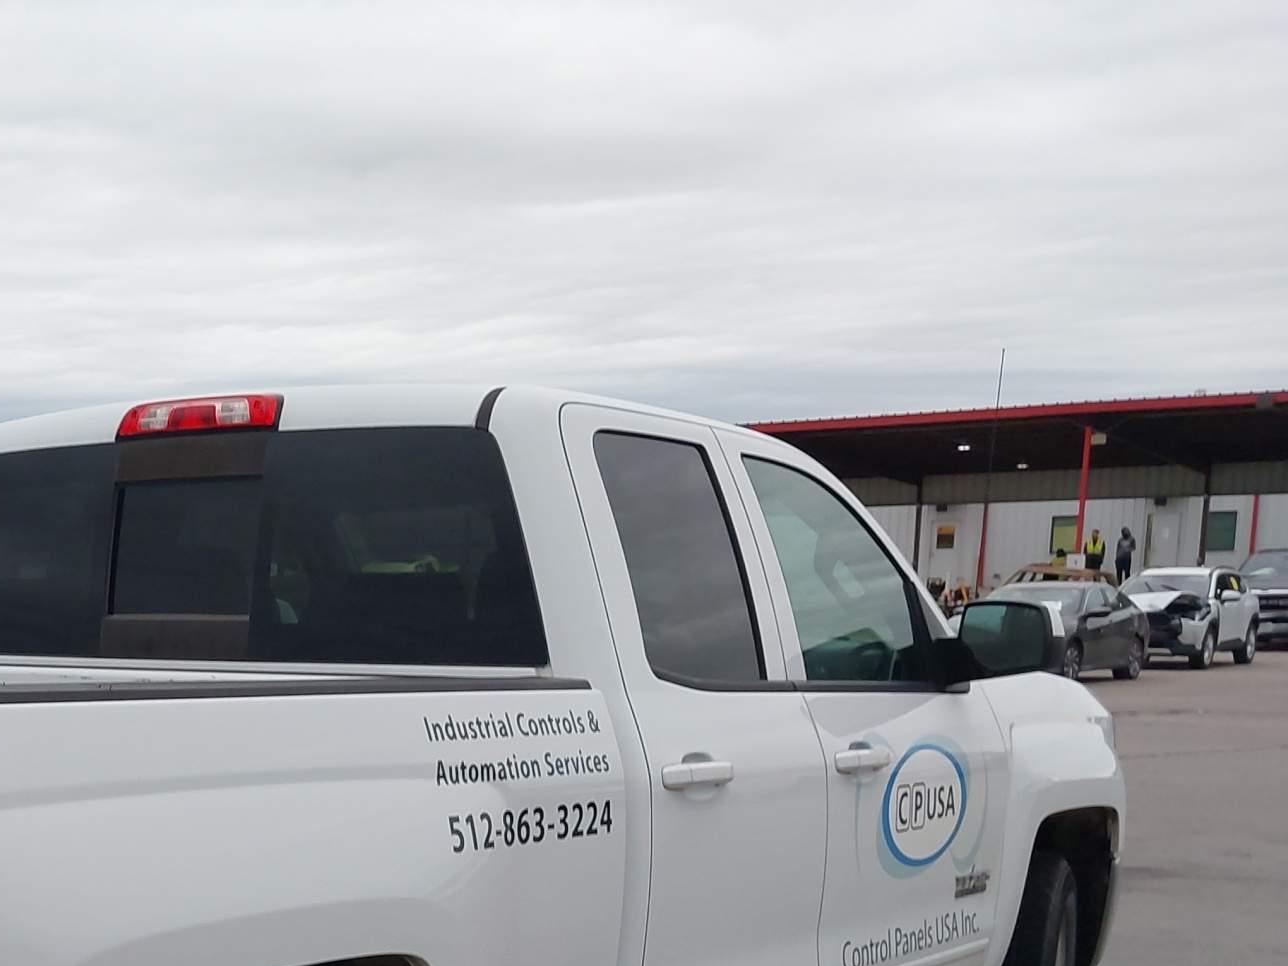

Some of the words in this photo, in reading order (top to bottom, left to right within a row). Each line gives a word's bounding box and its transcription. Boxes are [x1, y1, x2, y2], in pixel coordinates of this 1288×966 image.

[423, 712, 513, 742] Industrial
[516, 709, 585, 737] Controls
[588, 709, 601, 733] &
[436, 754, 541, 786] Automation
[544, 749, 610, 776] Services
[448, 800, 613, 853] 512-863-3224
[895, 919, 934, 958] Panels
[935, 911, 959, 944] USA
[961, 909, 980, 936] Inc.
